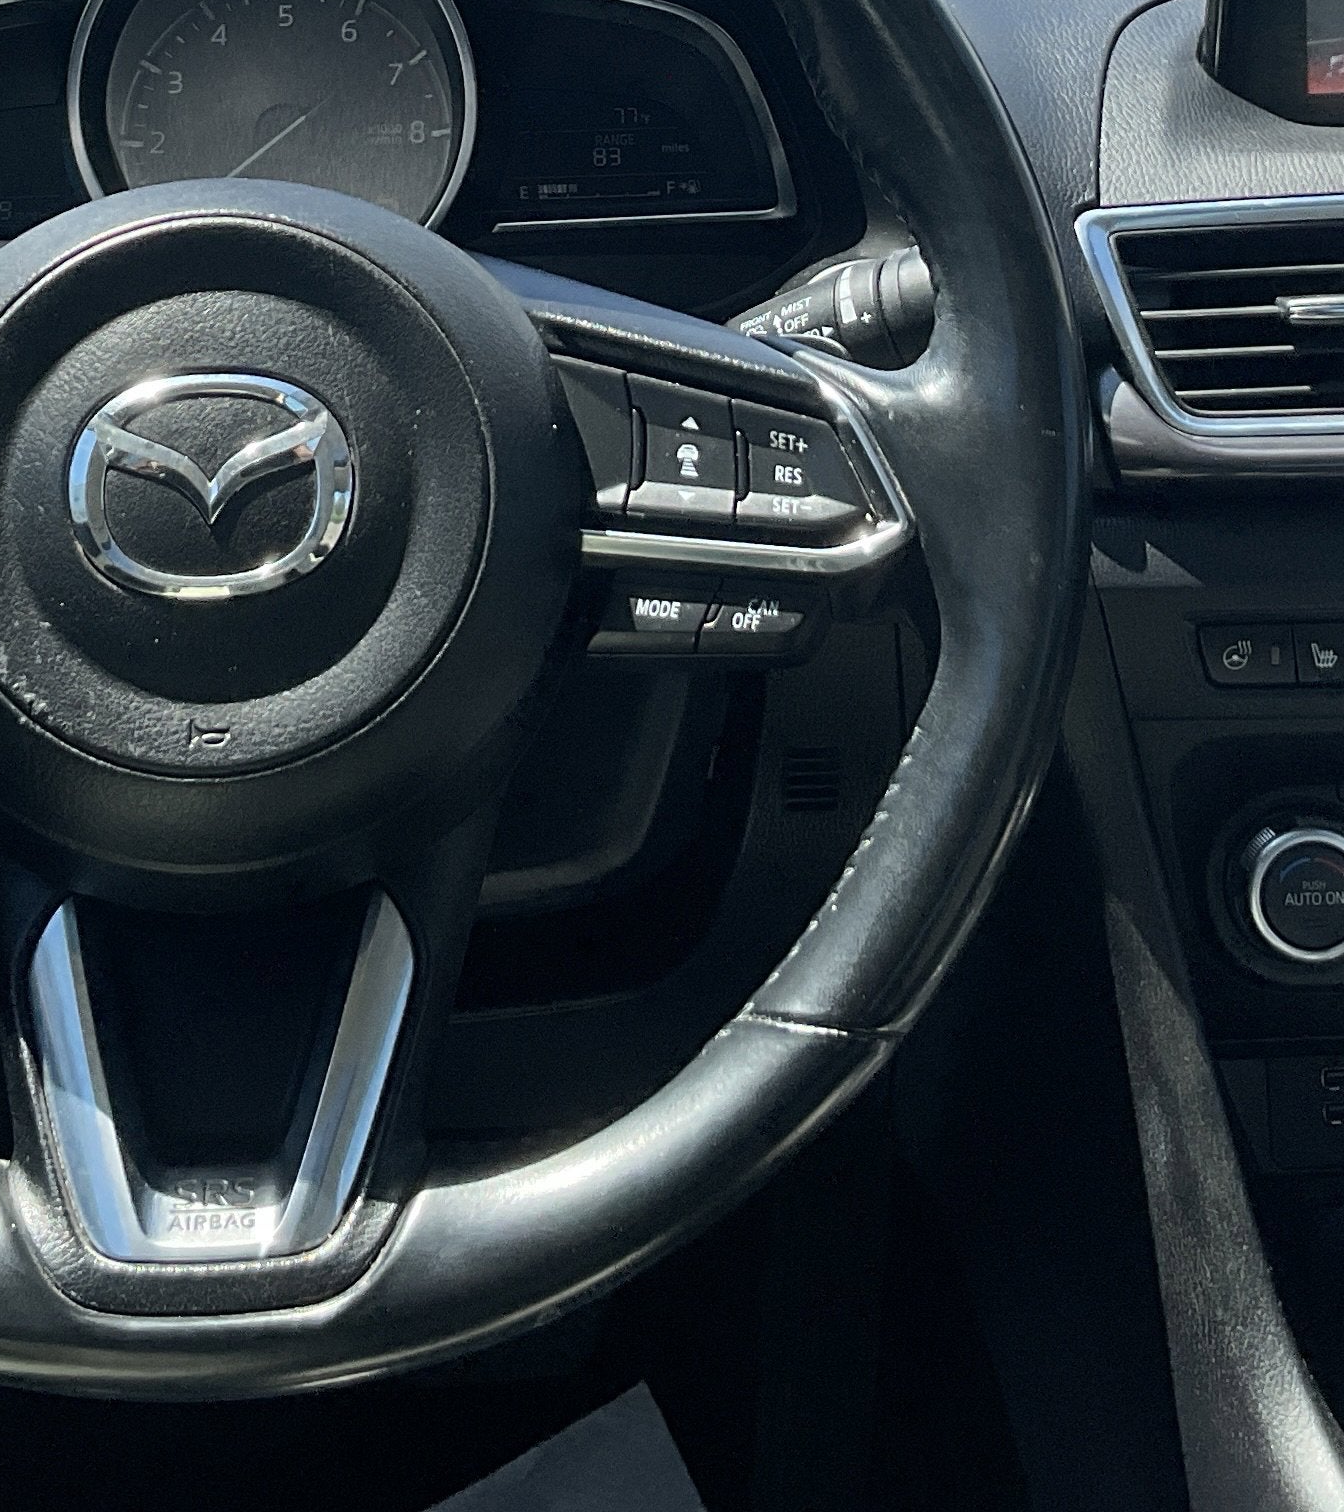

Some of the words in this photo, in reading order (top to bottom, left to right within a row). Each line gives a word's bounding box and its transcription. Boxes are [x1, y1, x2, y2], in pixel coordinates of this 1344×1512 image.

[278, 4, 294, 27] 5
[210, 23, 228, 46] 4
[341, 20, 357, 43] 6
[168, 71, 183, 94] 3
[388, 62, 403, 85] 7
[150, 131, 165, 154] 2
[409, 120, 426, 144] 8
[595, 133, 636, 147] RANGE
[592, 147, 622, 168] 83
[661, 141, 690, 153] miles
[519, 185, 529, 199] E
[665, 180, 675, 195] F
[780, 296, 812, 317] MIST
[784, 313, 809, 333] OFF
[775, 465, 803, 486] RES
[635, 599, 681, 620] MODE
[732, 612, 761, 632] OFF
[1302, 880, 1326, 890] PUSH
[1284, 892, 1322, 906] AUTO
[173, 1177, 256, 1208] SRS
[168, 1213, 256, 1232] AIRBAG
